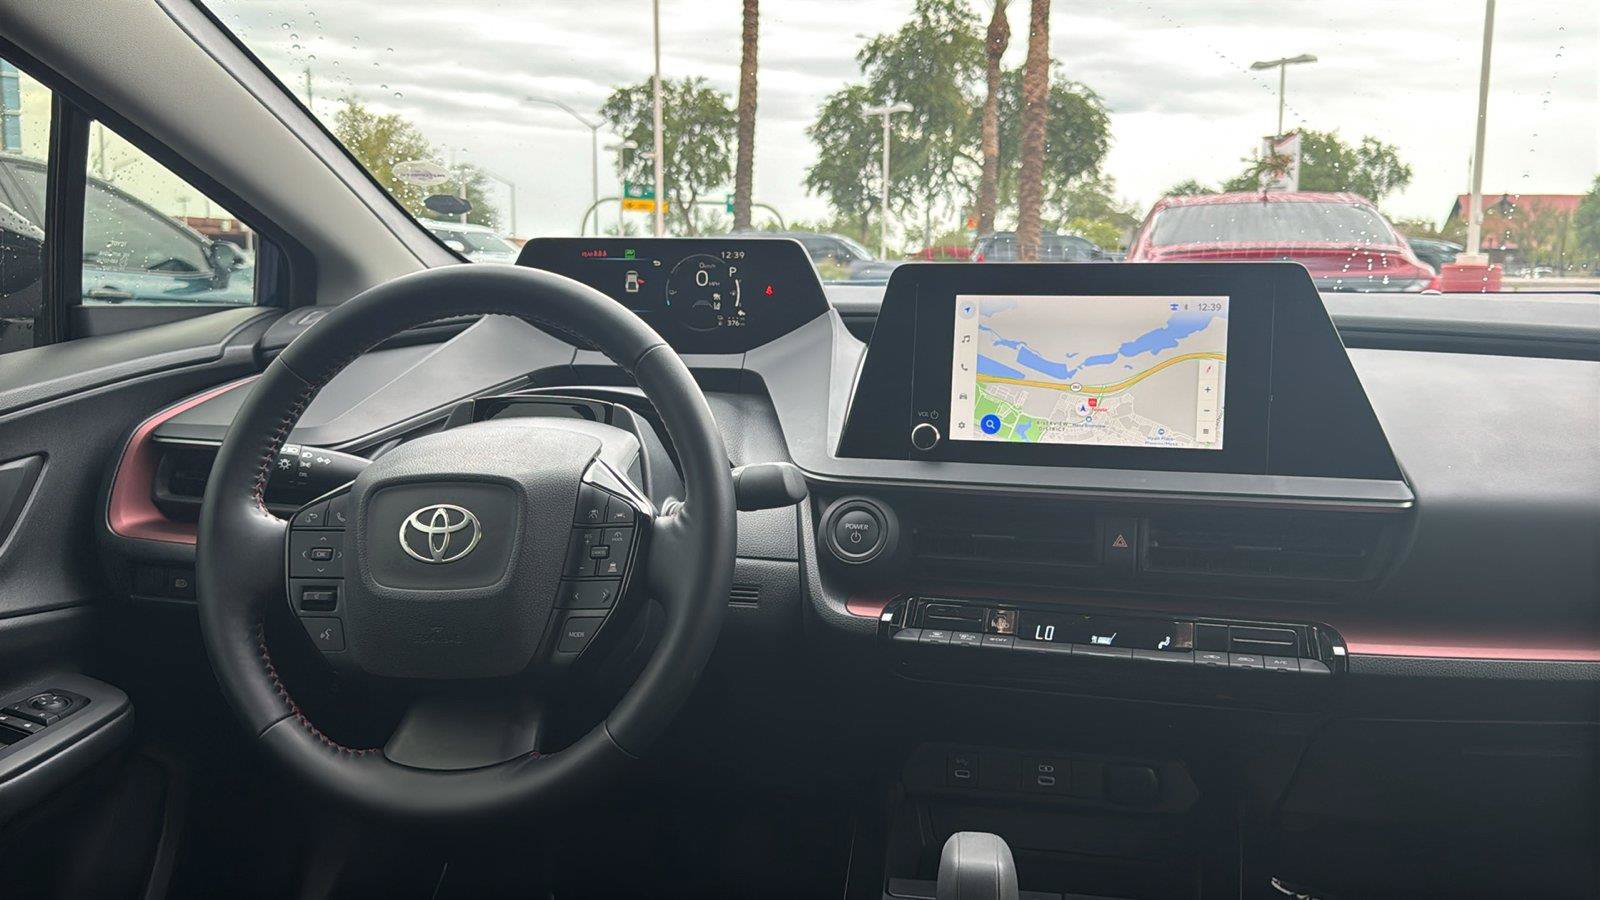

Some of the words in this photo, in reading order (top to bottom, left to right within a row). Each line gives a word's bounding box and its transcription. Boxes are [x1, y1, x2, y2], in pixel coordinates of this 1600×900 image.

[720, 251, 745, 259] 12:39
[729, 266, 737, 278] P
[695, 270, 709, 286] 0
[1198, 302, 1222, 312] 12:39
[727, 319, 740, 327] 376
[917, 409, 929, 417] VOL
[845, 522, 869, 531] POWER
[315, 550, 327, 558] OK
[568, 630, 585, 639] MODE
[1034, 624, 1056, 642] LO
